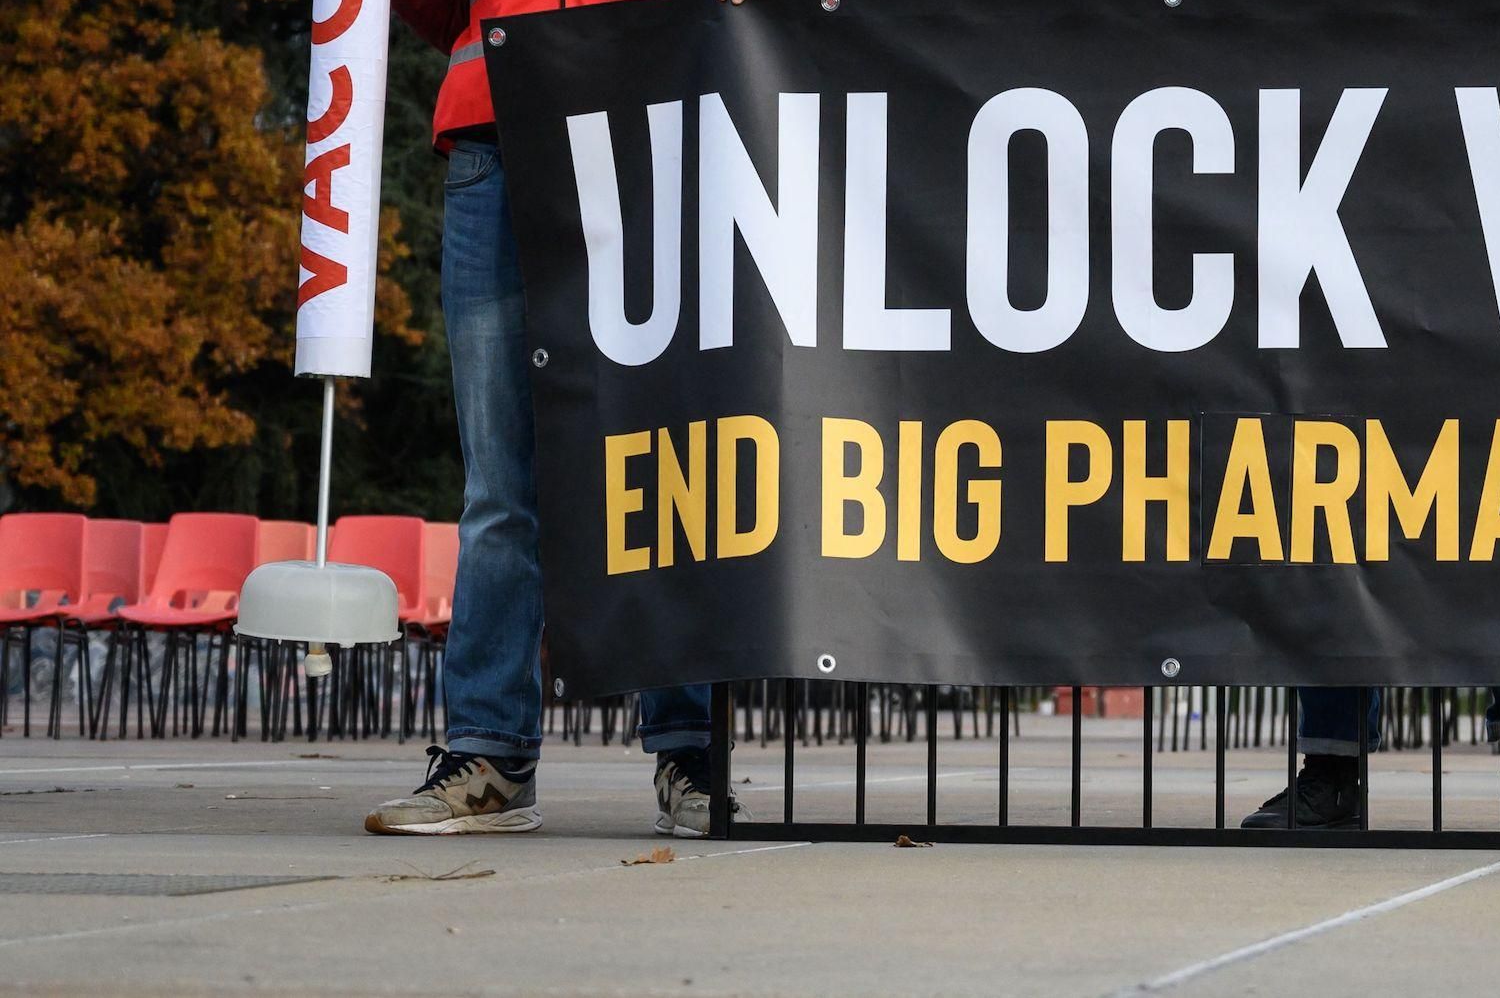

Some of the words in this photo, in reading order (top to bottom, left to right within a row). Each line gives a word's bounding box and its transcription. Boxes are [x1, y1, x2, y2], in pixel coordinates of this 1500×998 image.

[566, 86, 1389, 366] UNLOCK
[605, 415, 780, 575] END
[822, 418, 1002, 563] BIG
